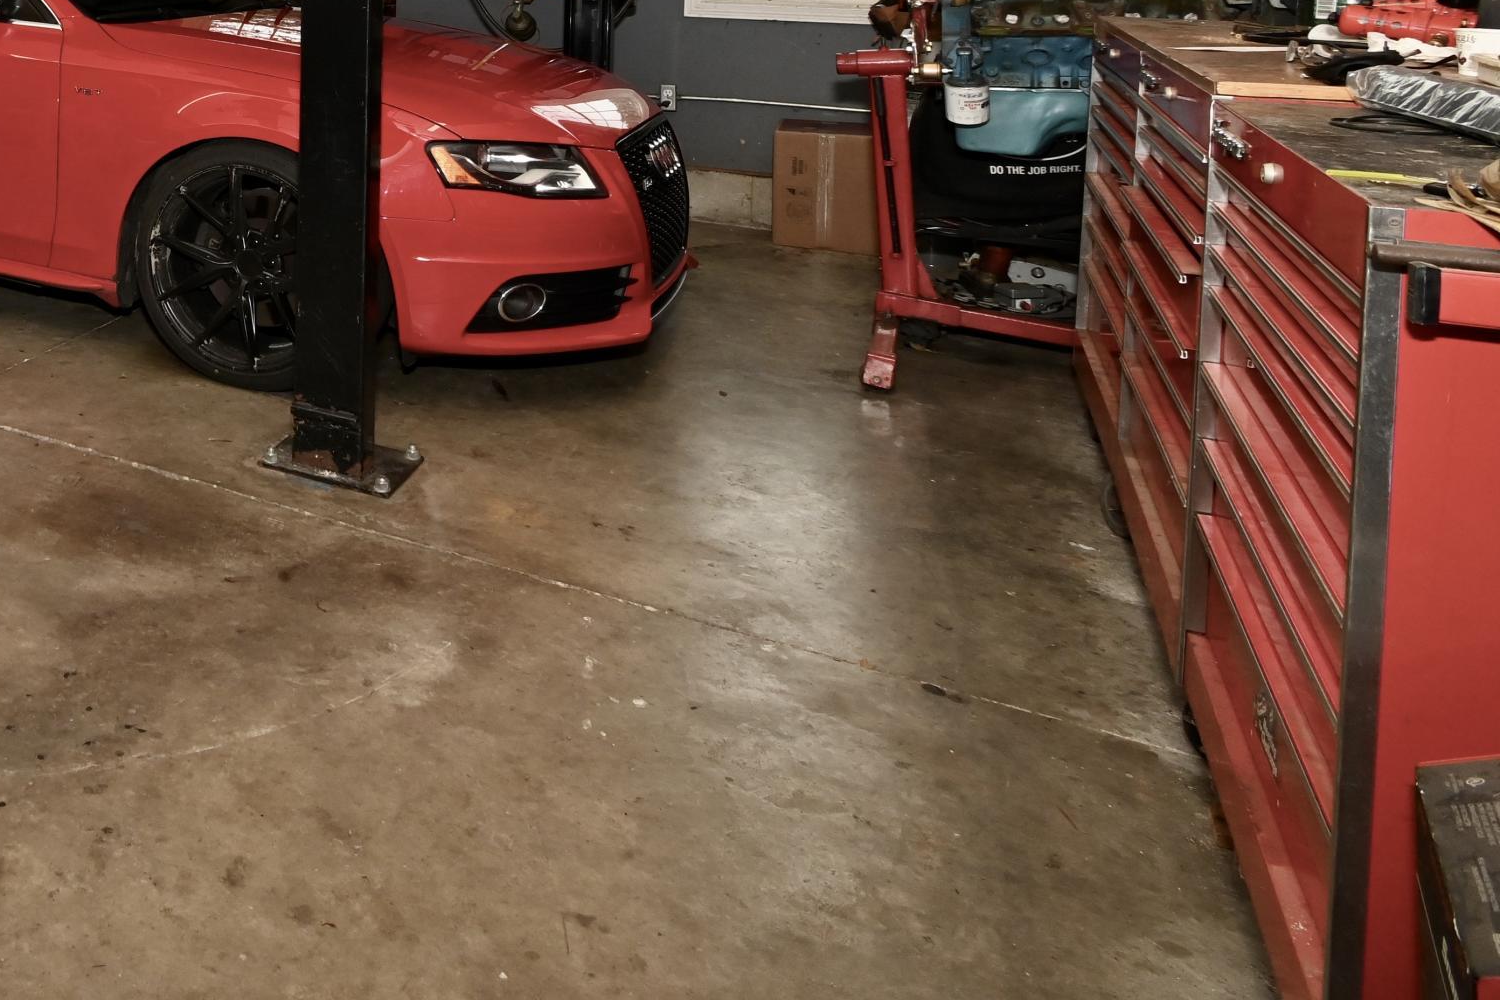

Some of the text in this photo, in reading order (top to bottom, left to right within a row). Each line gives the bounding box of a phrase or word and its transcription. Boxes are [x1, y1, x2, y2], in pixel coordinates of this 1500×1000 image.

[989, 165, 1004, 175] DO
[1007, 165, 1025, 175] THE
[1027, 166, 1048, 175] JOB
